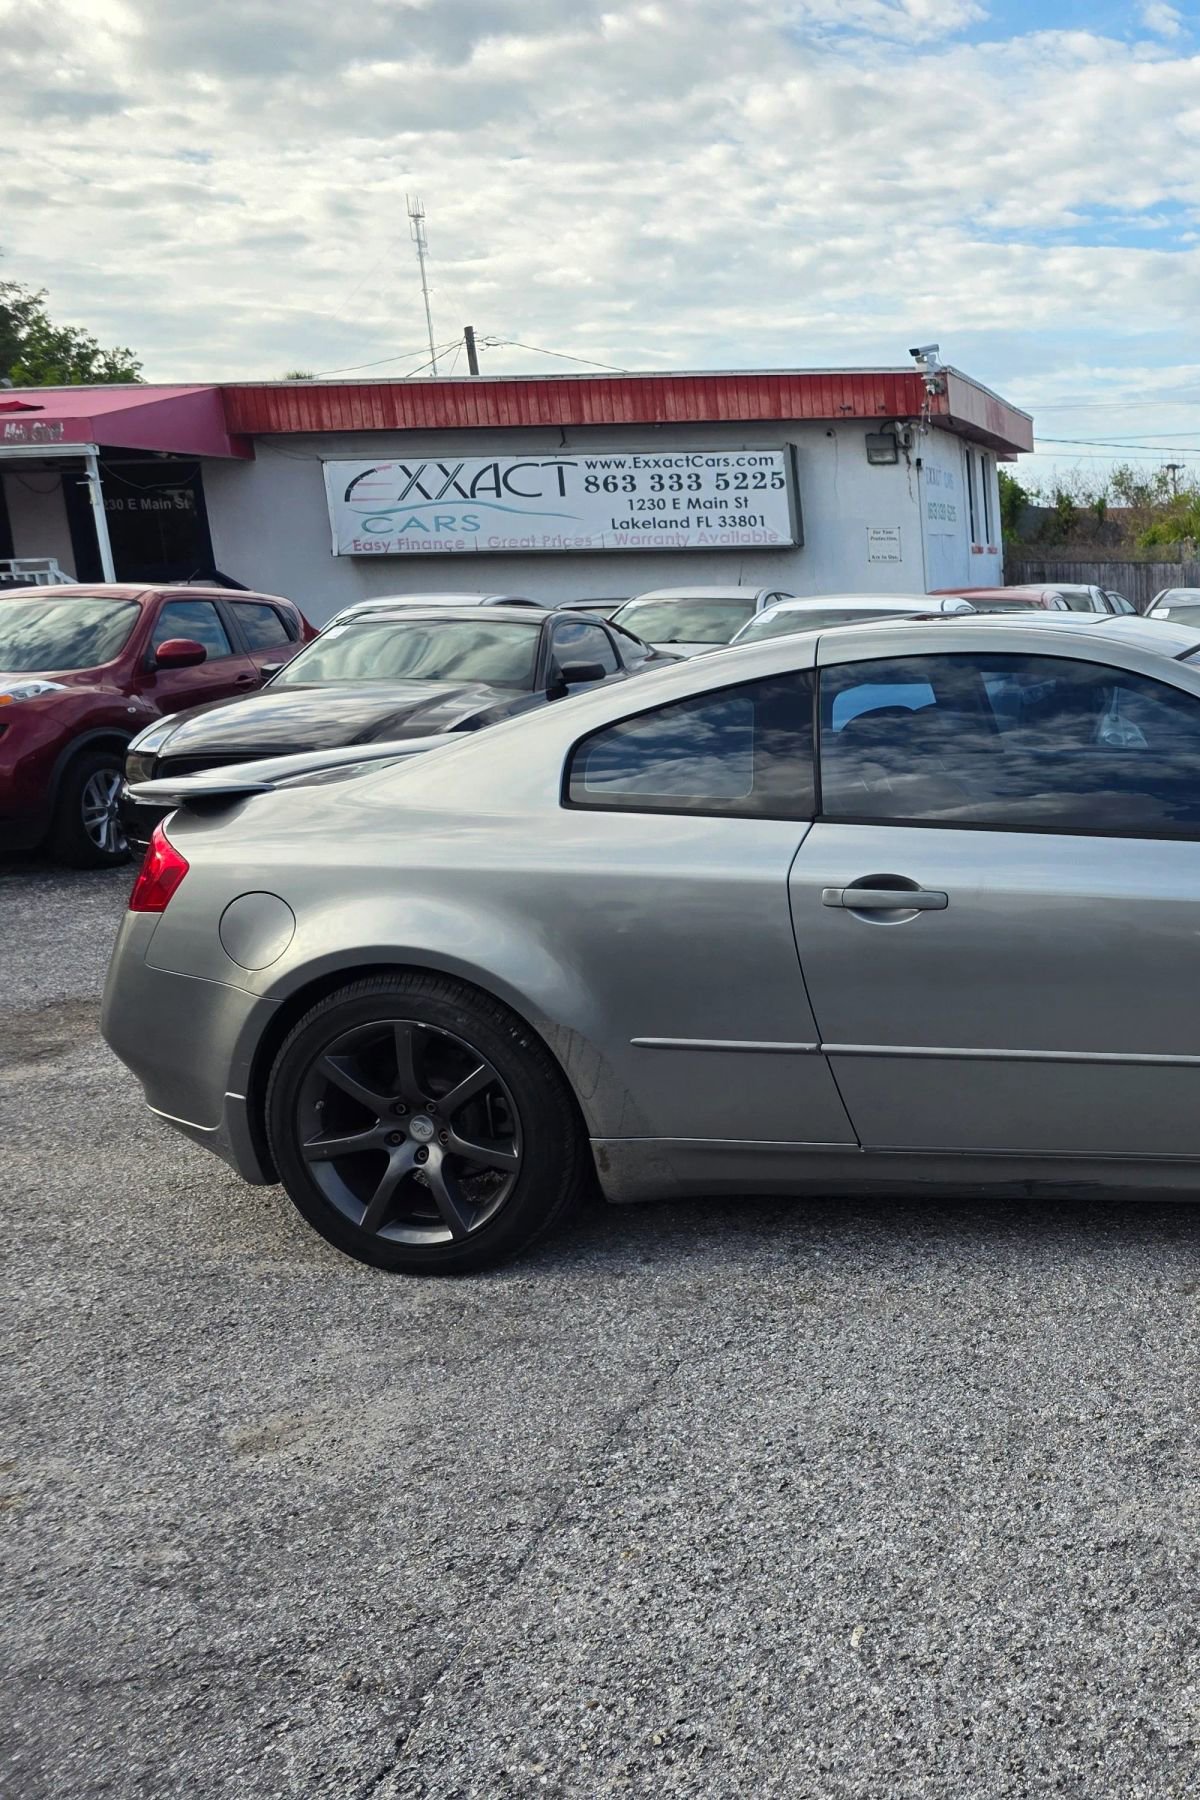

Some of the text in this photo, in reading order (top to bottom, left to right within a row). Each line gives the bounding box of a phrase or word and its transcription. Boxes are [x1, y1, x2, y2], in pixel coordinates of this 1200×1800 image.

[585, 455, 774, 469] www.ExxactCars.com
[344, 461, 578, 502] EXXACT
[584, 471, 785, 493] 863 333 5225
[103, 497, 190, 510] 230 E Main St
[628, 496, 749, 511] 1230 E Main St
[361, 515, 481, 534] CARS
[611, 515, 766, 530] Lakeland FL 33801
[353, 530, 779, 553] Easy Finance Great Prices Warranty Available
